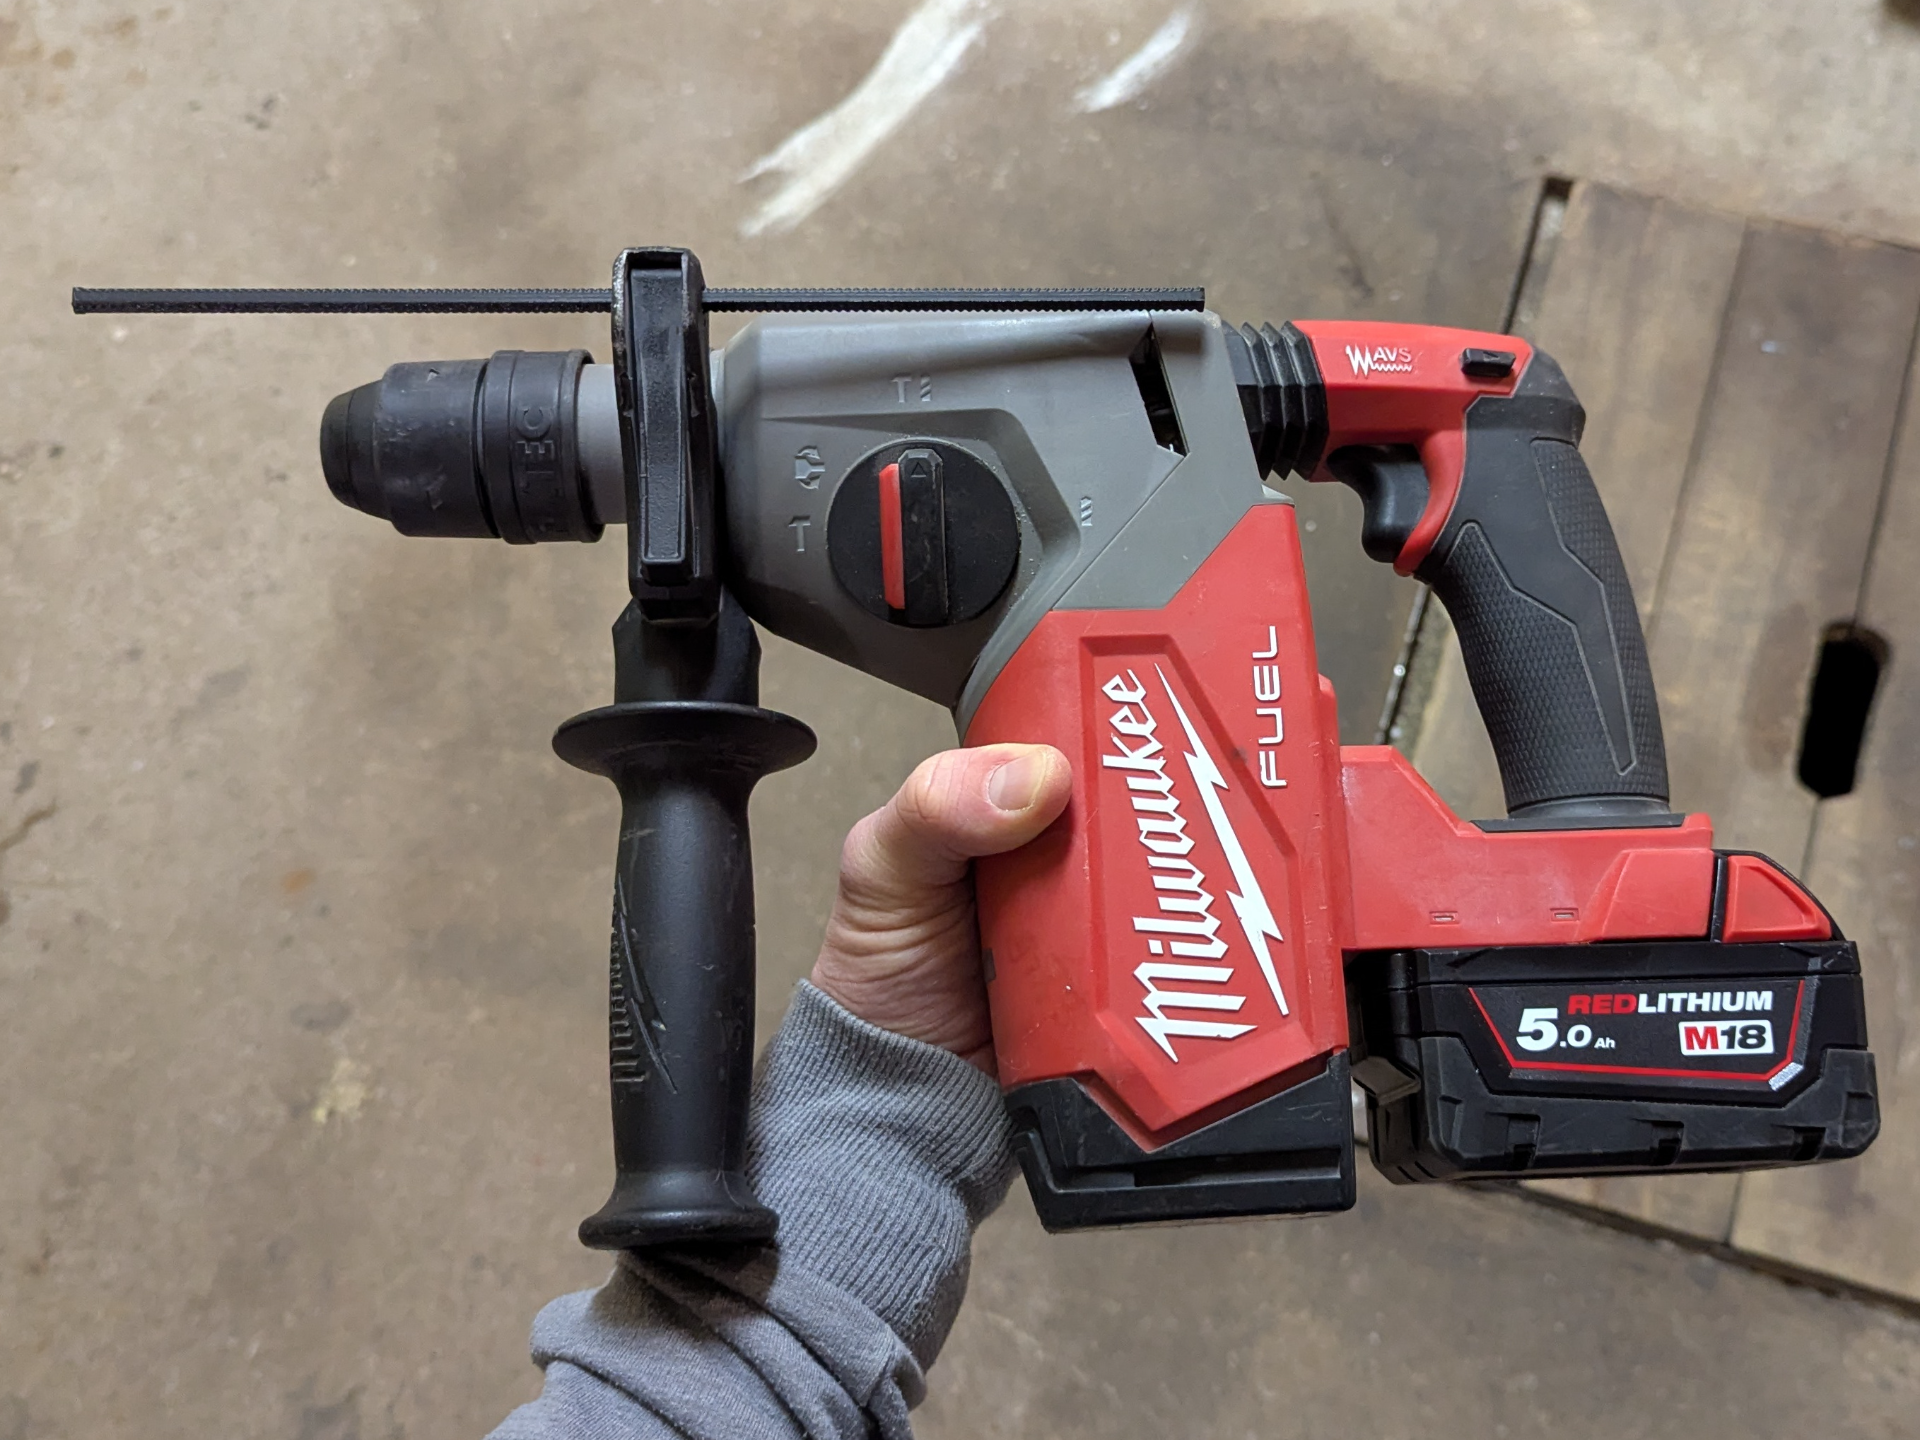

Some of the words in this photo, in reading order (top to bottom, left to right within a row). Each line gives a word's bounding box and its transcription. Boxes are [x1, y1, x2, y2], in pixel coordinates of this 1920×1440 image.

[1252, 625, 1288, 789] FUEL
[1101, 668, 1259, 1063] Milwaukee
[1567, 990, 1773, 1015] REDLITHIUM
[1684, 1024, 1767, 1051] M18
